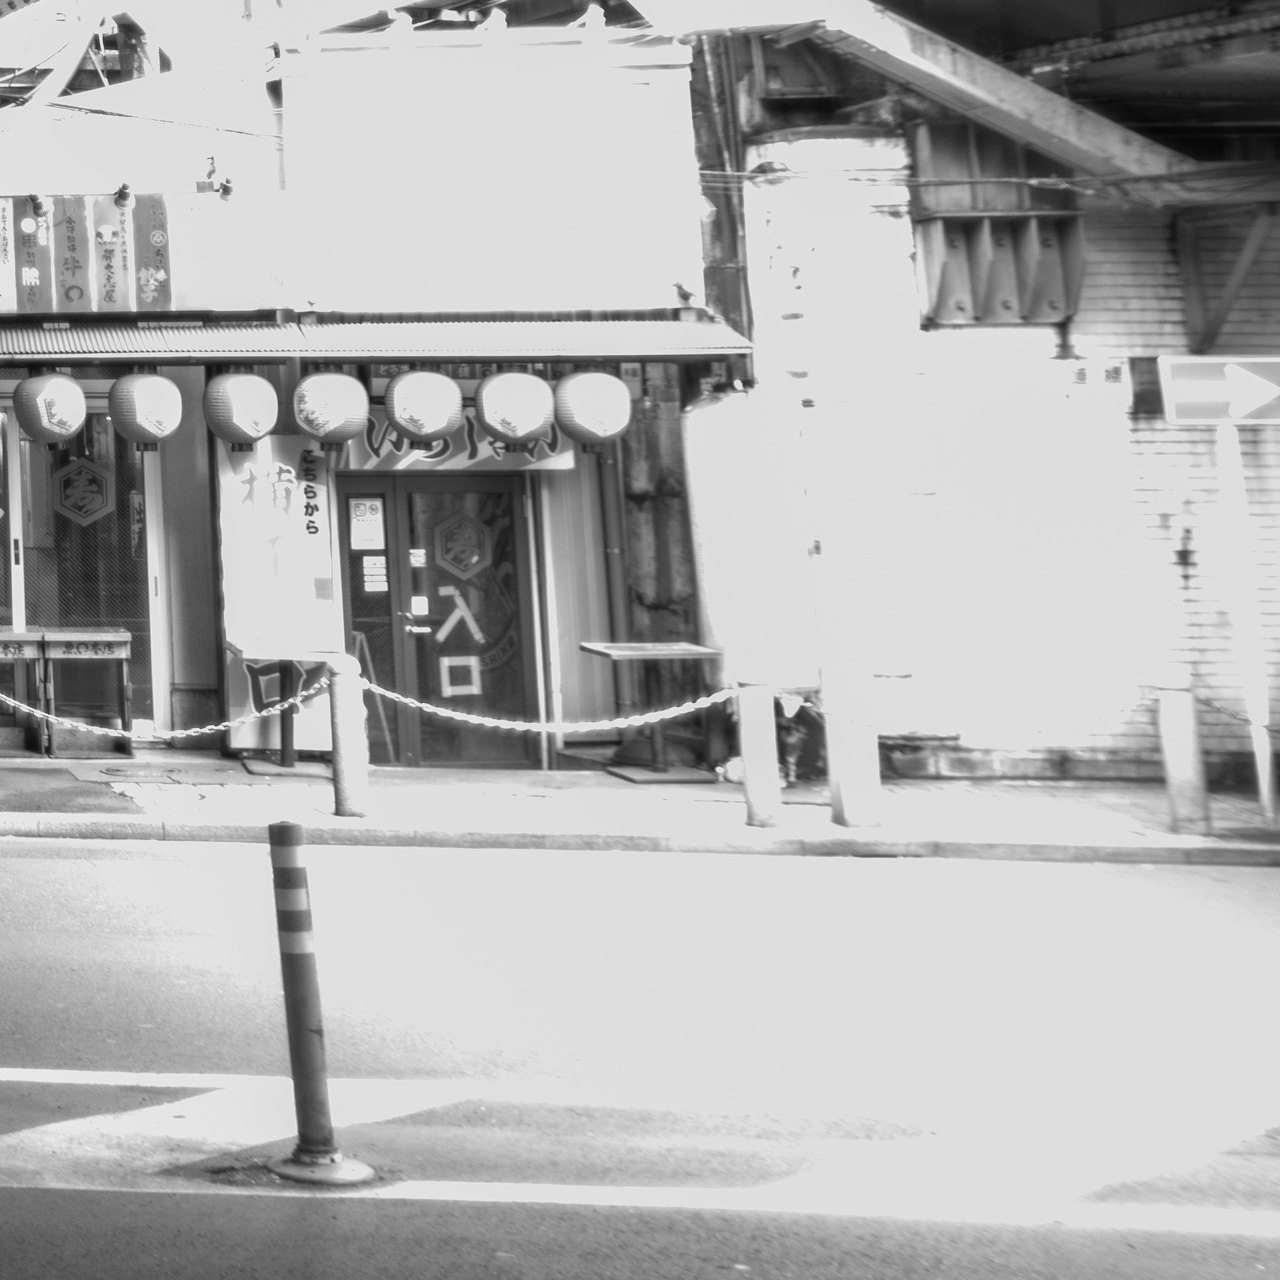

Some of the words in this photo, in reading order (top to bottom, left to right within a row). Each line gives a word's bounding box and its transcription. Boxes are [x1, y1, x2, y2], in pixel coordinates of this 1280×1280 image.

[302, 449, 320, 535] こちらから
[434, 585, 486, 698] 入口
